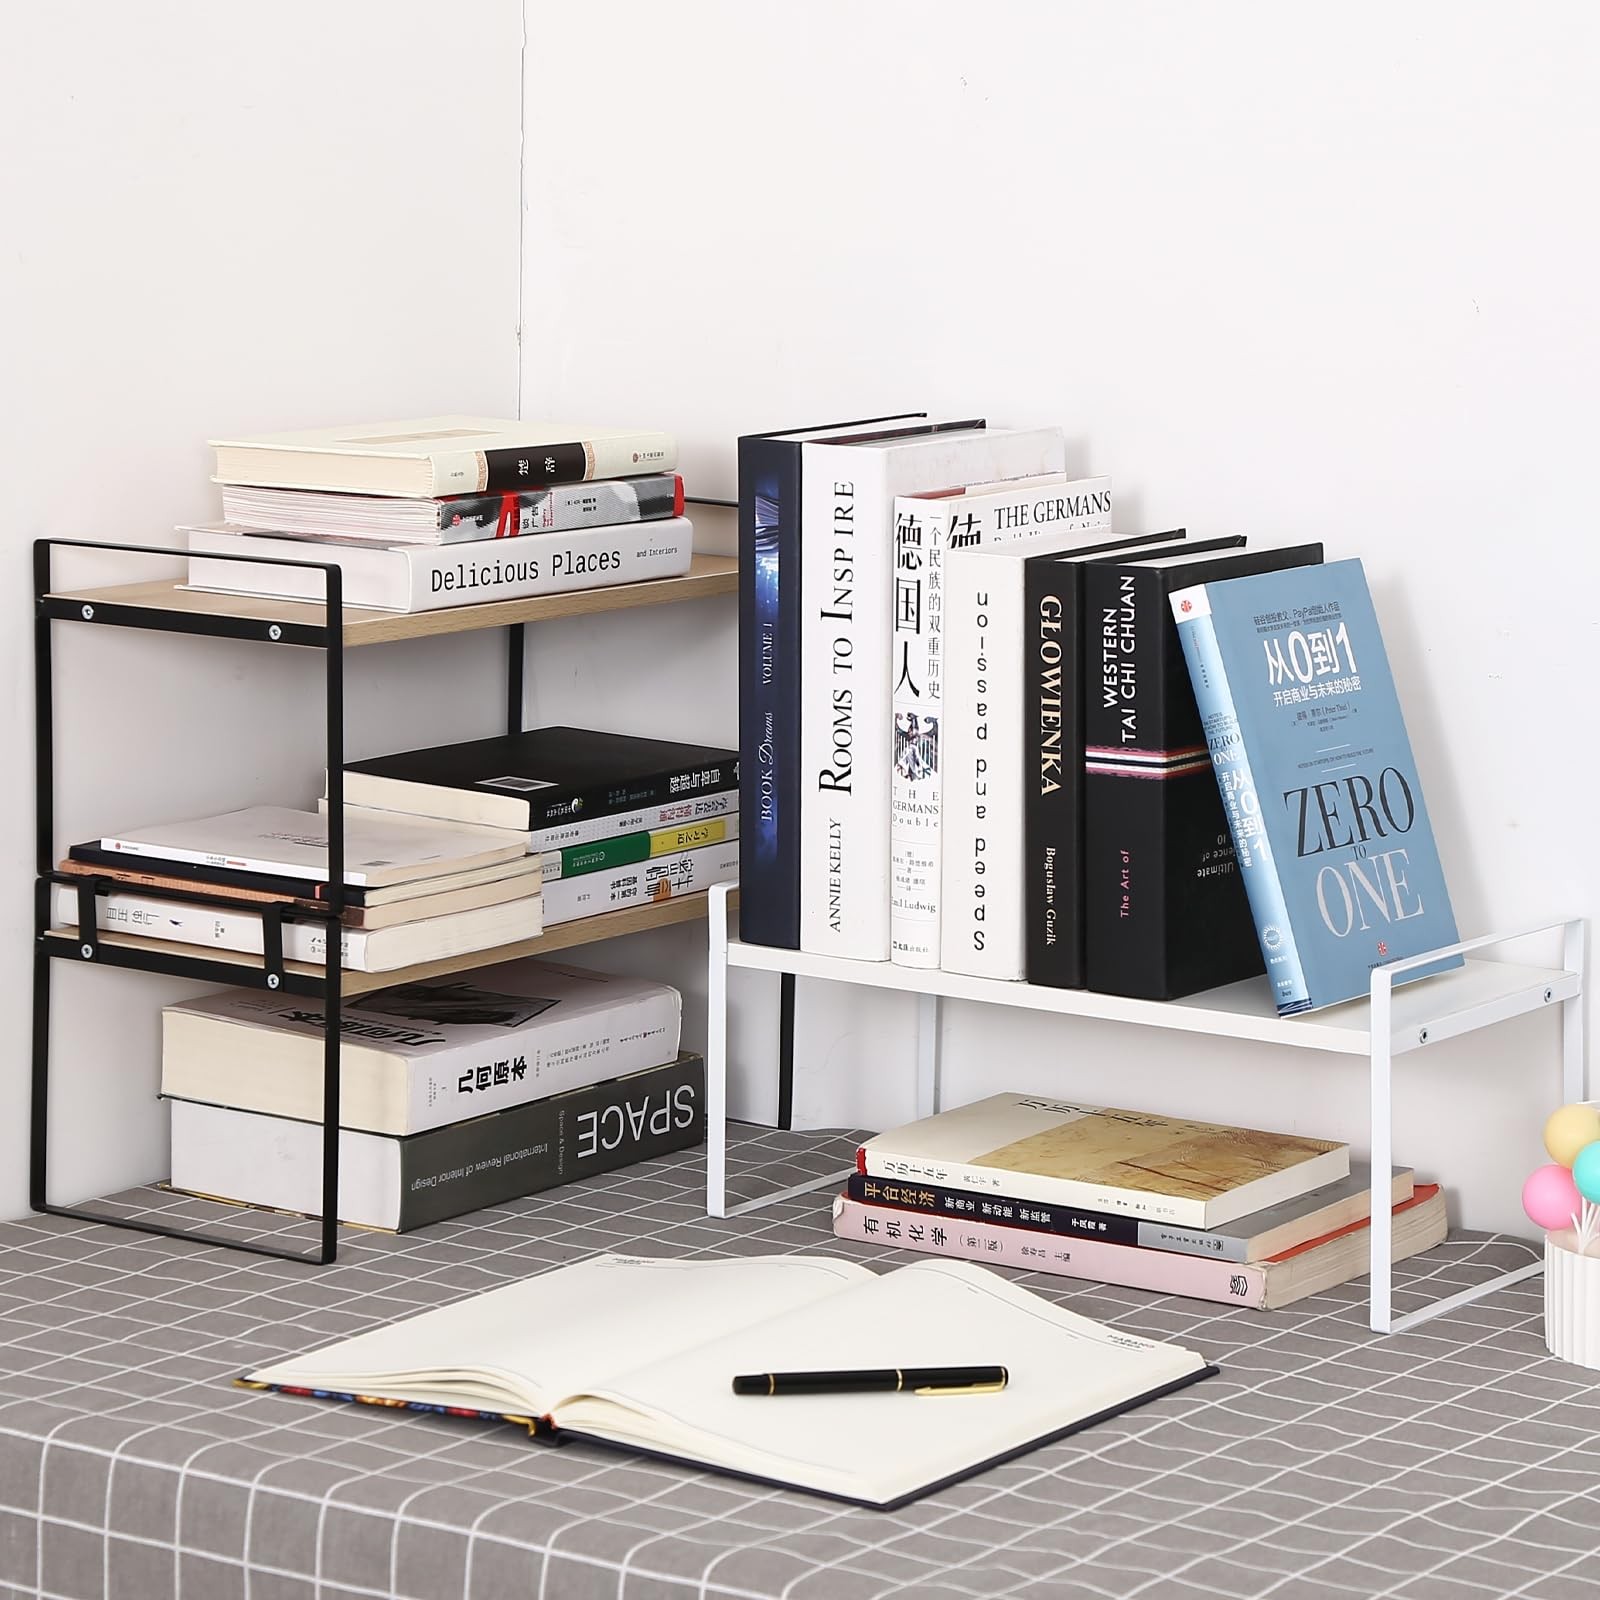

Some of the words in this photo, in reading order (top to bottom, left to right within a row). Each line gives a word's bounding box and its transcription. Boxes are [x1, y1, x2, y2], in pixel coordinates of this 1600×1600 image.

[994, 504, 1029, 530] THE
[1033, 490, 1111, 524] GERMANS
[431, 560, 539, 593] Delicious
[552, 550, 621, 577] Places
[636, 550, 647, 558] and
[649, 547, 678, 557] Interiors
[820, 481, 854, 624] INSPIRE
[894, 513, 923, 698] 德国人
[928, 516, 942, 700] 一个民族的双重历史
[1120, 575, 1136, 656] CHUAN
[762, 630, 773, 685] VOLUME
[832, 637, 854, 675] TO
[1103, 608, 1117, 709] WESTERN
[1263, 622, 1358, 686] 从0到1
[1121, 662, 1136, 701] CHI
[1273, 676, 1362, 707] 开启商业与未来的秘密
[758, 711, 774, 766] Dreams
[818, 689, 853, 796] ROOMS
[1121, 708, 1136, 743] TAI
[1208, 732, 1240, 750] ZERO
[669, 769, 721, 794] 自卑与超越
[761, 769, 773, 822] BOOK
[893, 786, 939, 801] THE
[975, 757, 987, 819] and
[892, 800, 939, 815] GERMANS
[892, 813, 939, 828] Double
[1283, 766, 1415, 858] ZERO
[829, 817, 842, 875] KELLY
[1120, 849, 1130, 863] of
[1353, 845, 1367, 861] TO
[1120, 865, 1130, 890] Art
[1196, 862, 1235, 878] Ultimate
[829, 877, 842, 933] ANNIE
[904, 899, 937, 913] Ludwig
[974, 837, 986, 951] Speed
[1120, 895, 1130, 918] The
[1316, 848, 1425, 937] ONE
[1046, 908, 1056, 946] Guzik
[458, 1055, 527, 1094] 几何原本
[558, 1110, 566, 1137] Space
[576, 1083, 697, 1159] SPACE
[465, 1164, 474, 1175] of
[474, 1158, 502, 1173] Review
[503, 1142, 549, 1165] International
[557, 1145, 566, 1175] Design
[883, 1159, 949, 1181] 万历十五年
[411, 1175, 438, 1192] Design
[438, 1167, 465, 1183] Interior
[864, 1181, 936, 1208] 平台经济
[944, 1196, 976, 1213] 新商业
[981, 1202, 1013, 1219] 新动能
[1019, 1208, 1052, 1224] 新监管
[863, 1215, 948, 1247] 有机化学
